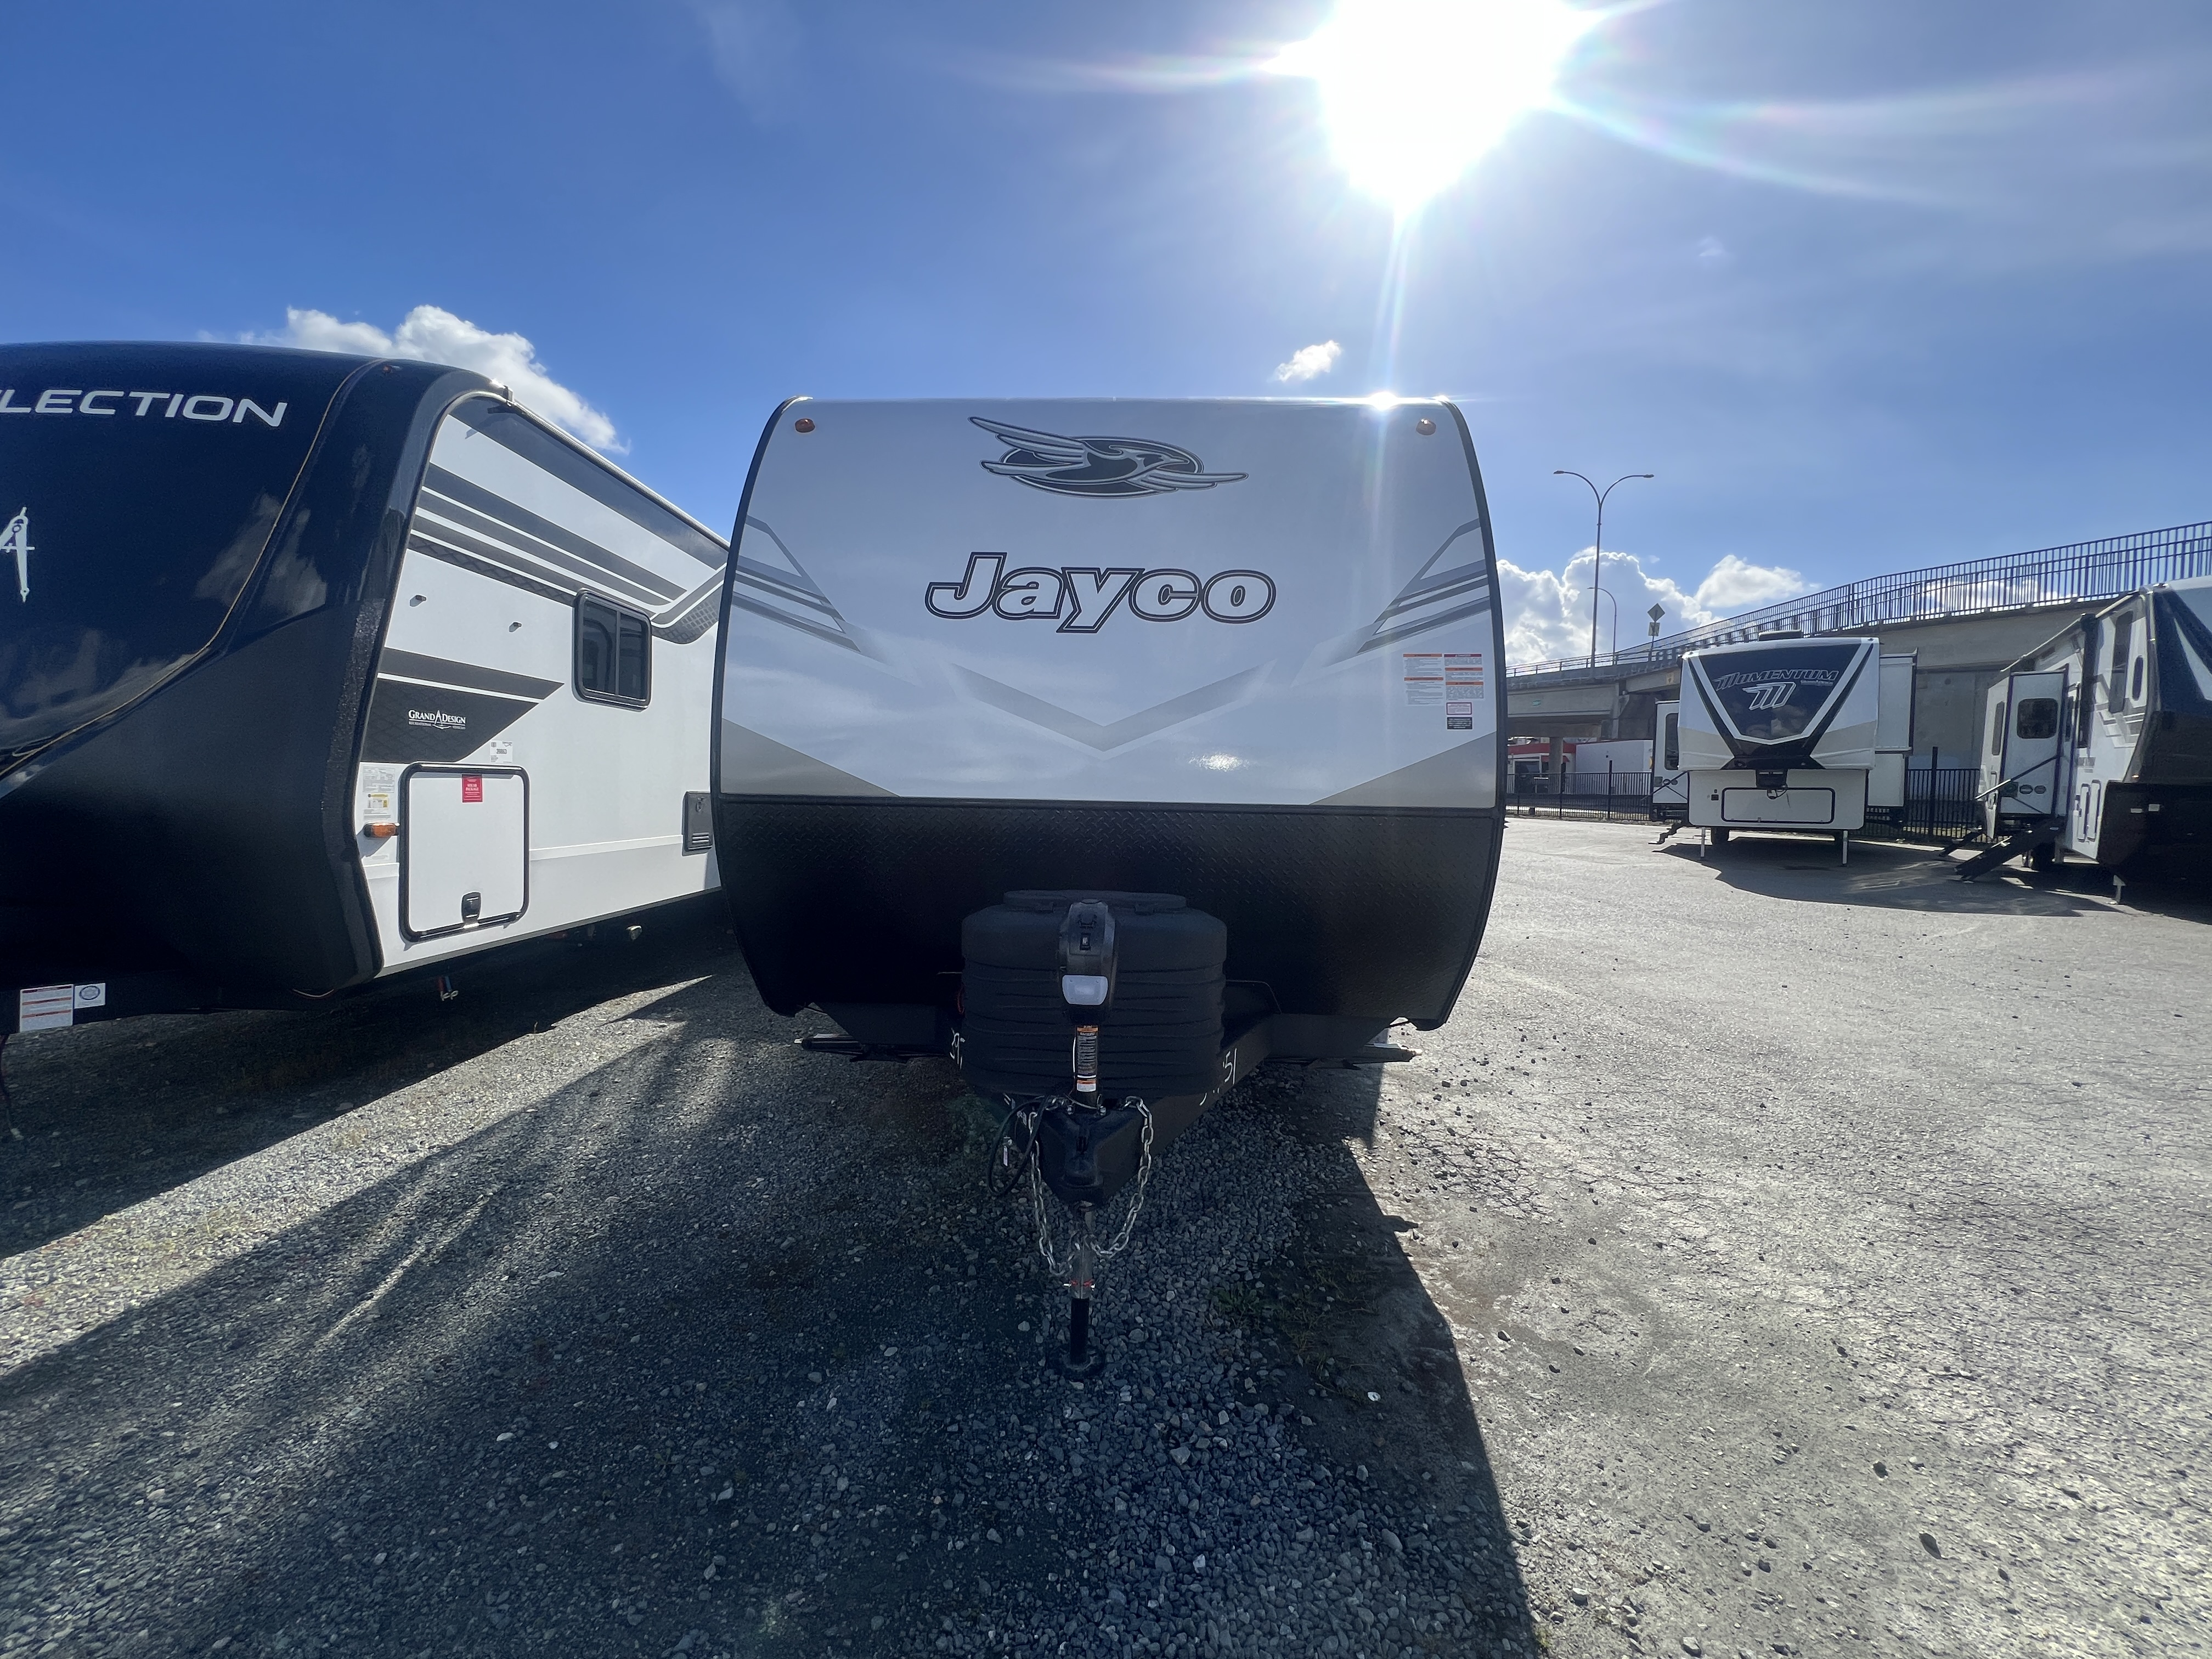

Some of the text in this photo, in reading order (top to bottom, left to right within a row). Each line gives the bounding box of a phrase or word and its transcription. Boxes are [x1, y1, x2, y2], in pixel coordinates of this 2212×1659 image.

[0, 389, 288, 427] LECTION
[925, 552, 1277, 634] Jayco
[1712, 669, 1839, 691] MOMENTUM
[408, 709, 466, 724] GRAND DESIGN
